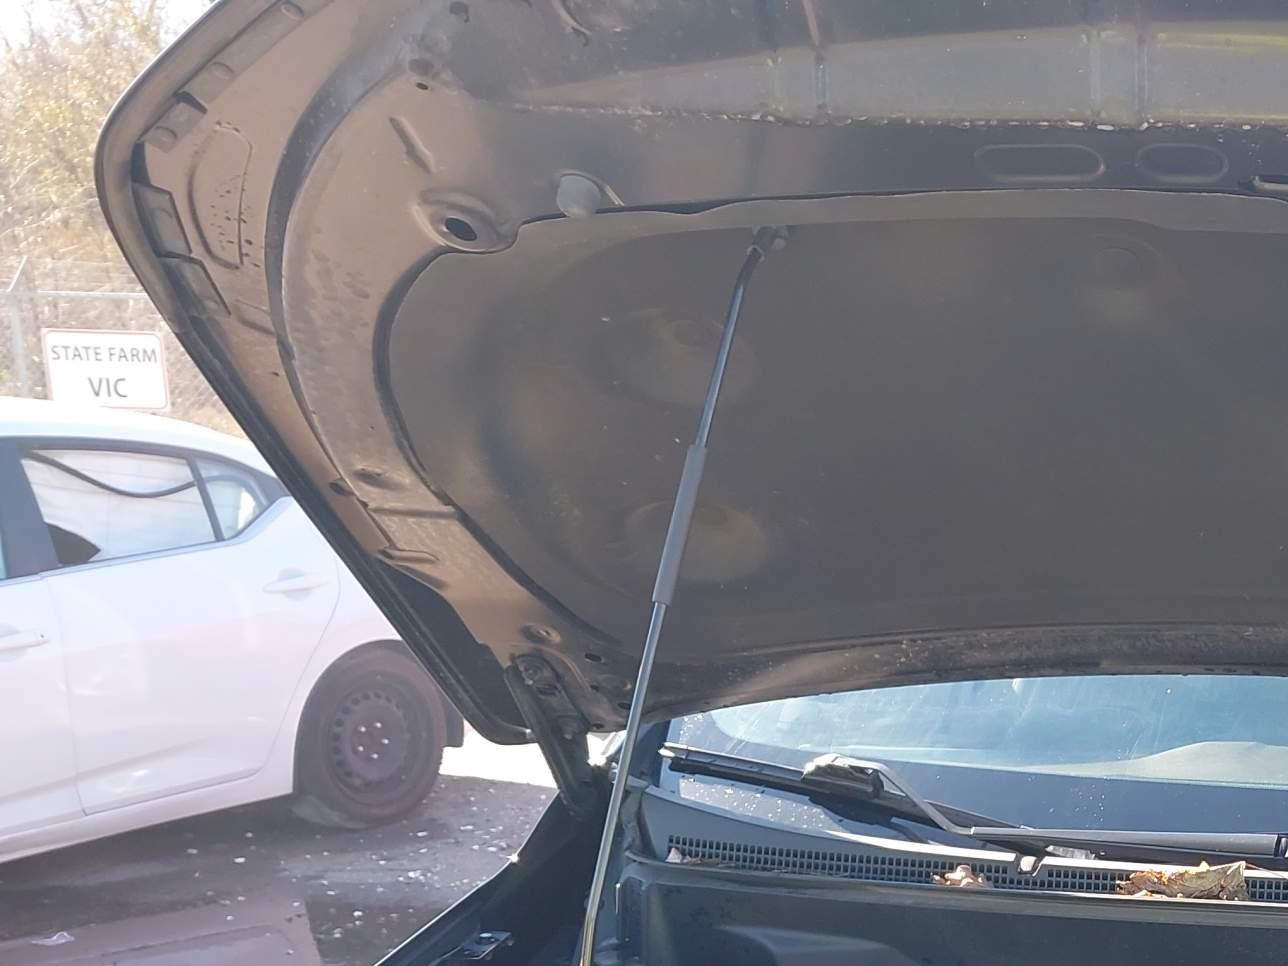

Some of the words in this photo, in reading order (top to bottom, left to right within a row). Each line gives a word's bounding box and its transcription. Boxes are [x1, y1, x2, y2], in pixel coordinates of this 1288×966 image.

[51, 345, 102, 363] STATE
[108, 346, 158, 364] FARM
[88, 376, 129, 398] VIC
